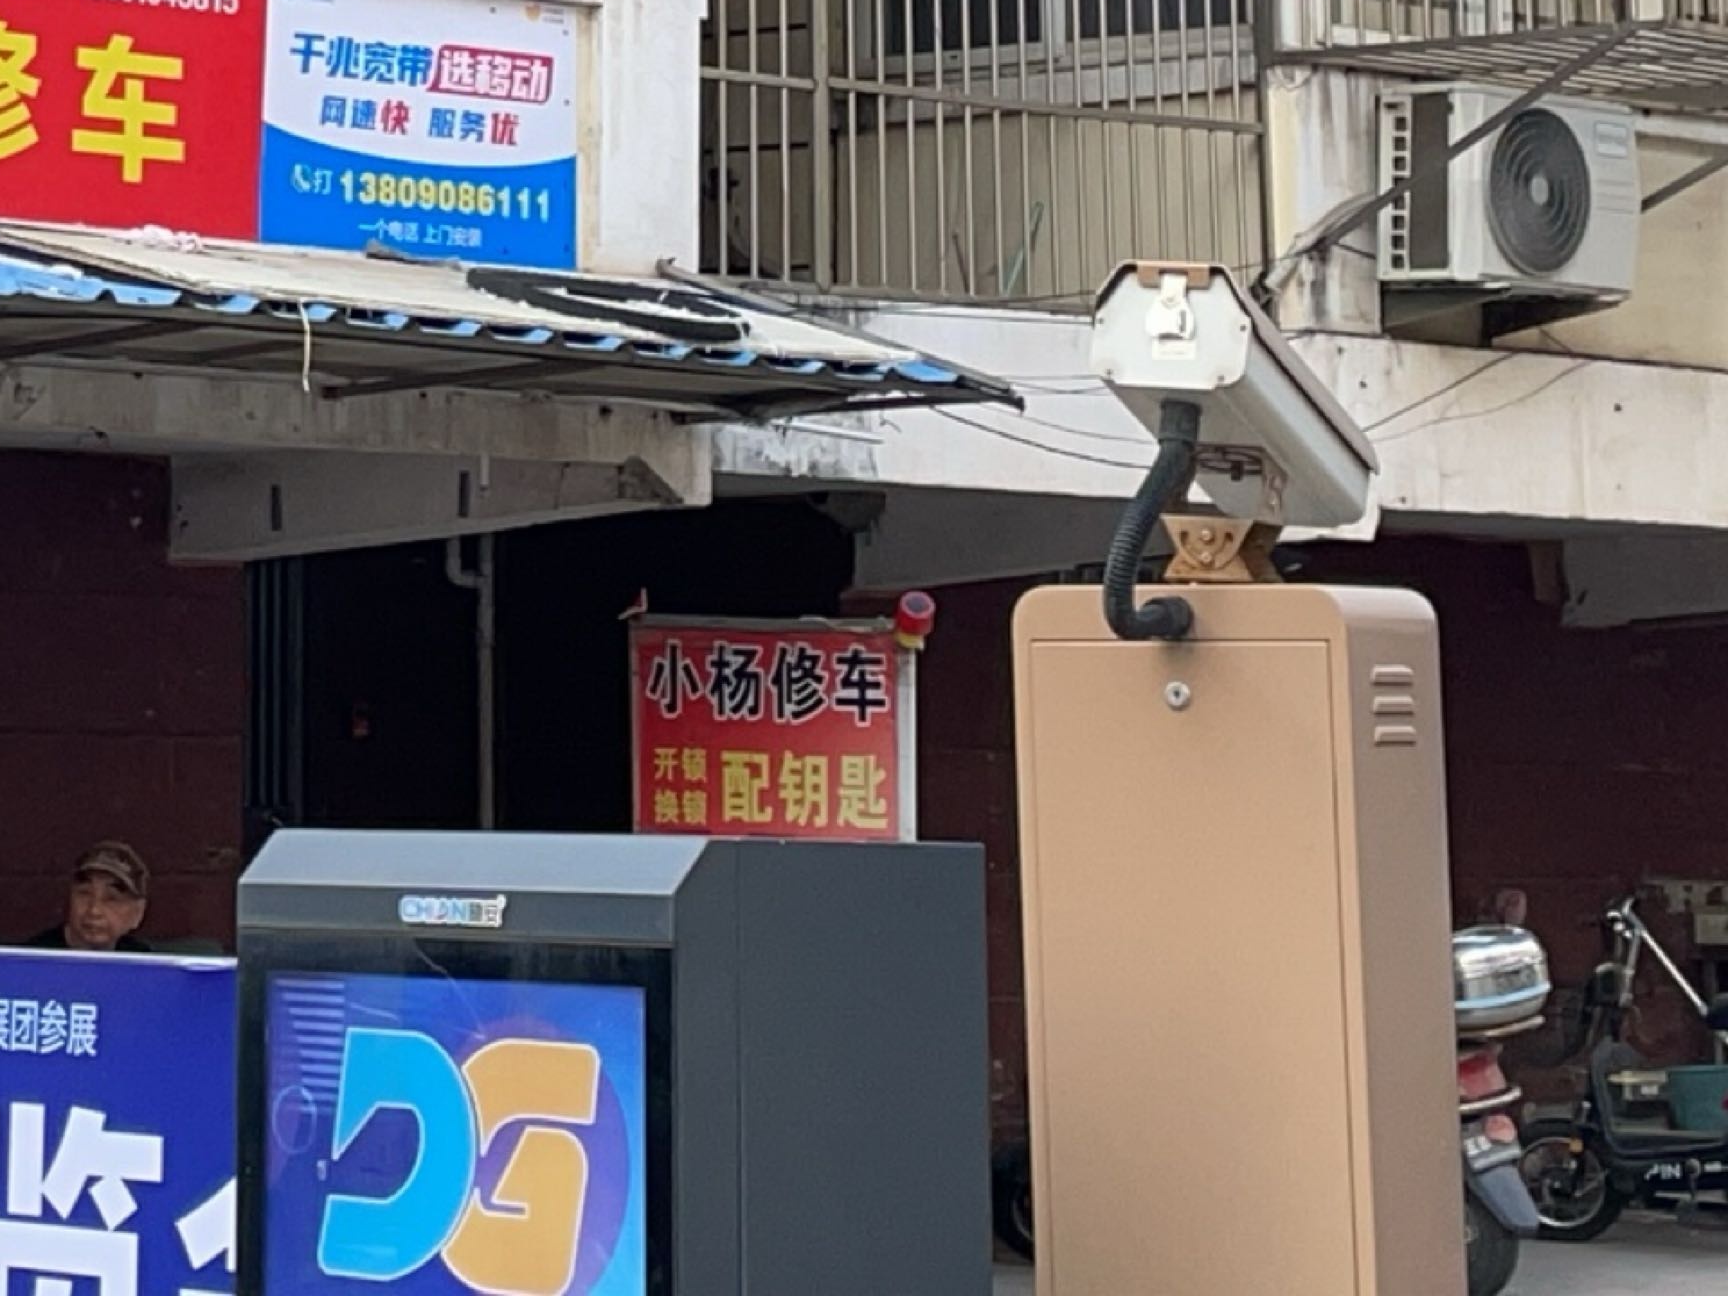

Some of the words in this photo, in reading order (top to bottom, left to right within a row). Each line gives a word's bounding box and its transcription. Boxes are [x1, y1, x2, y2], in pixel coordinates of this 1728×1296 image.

[319, 94, 410, 136] 网速快
[427, 107, 520, 146] 服务优
[340, 169, 550, 223] 13809086111
[645, 638, 890, 727] 小杨修车
[652, 747, 708, 782] 开锁
[720, 750, 889, 829] 配钥匙
[653, 788, 708, 825] 换锁
